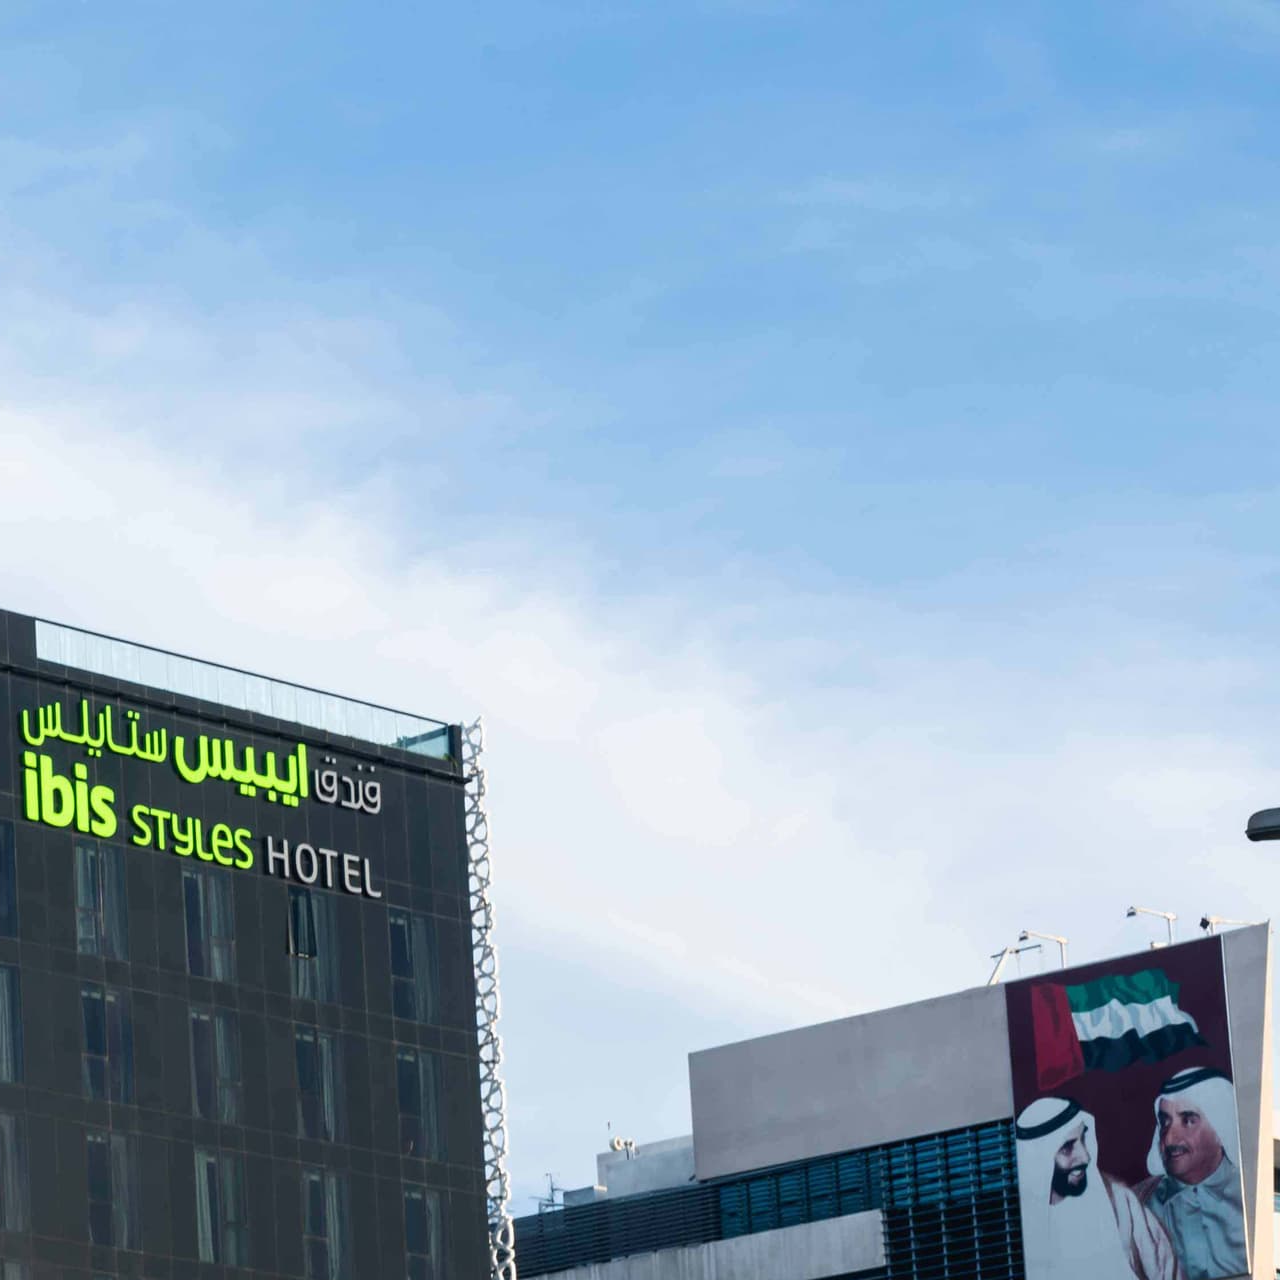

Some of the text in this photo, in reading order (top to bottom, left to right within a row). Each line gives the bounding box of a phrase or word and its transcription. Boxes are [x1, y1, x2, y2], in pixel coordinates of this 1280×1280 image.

[21, 699, 382, 814] فندق ايبيس ستايلس
[23, 751, 118, 839] ibis
[267, 834, 382, 898] HOTEL
